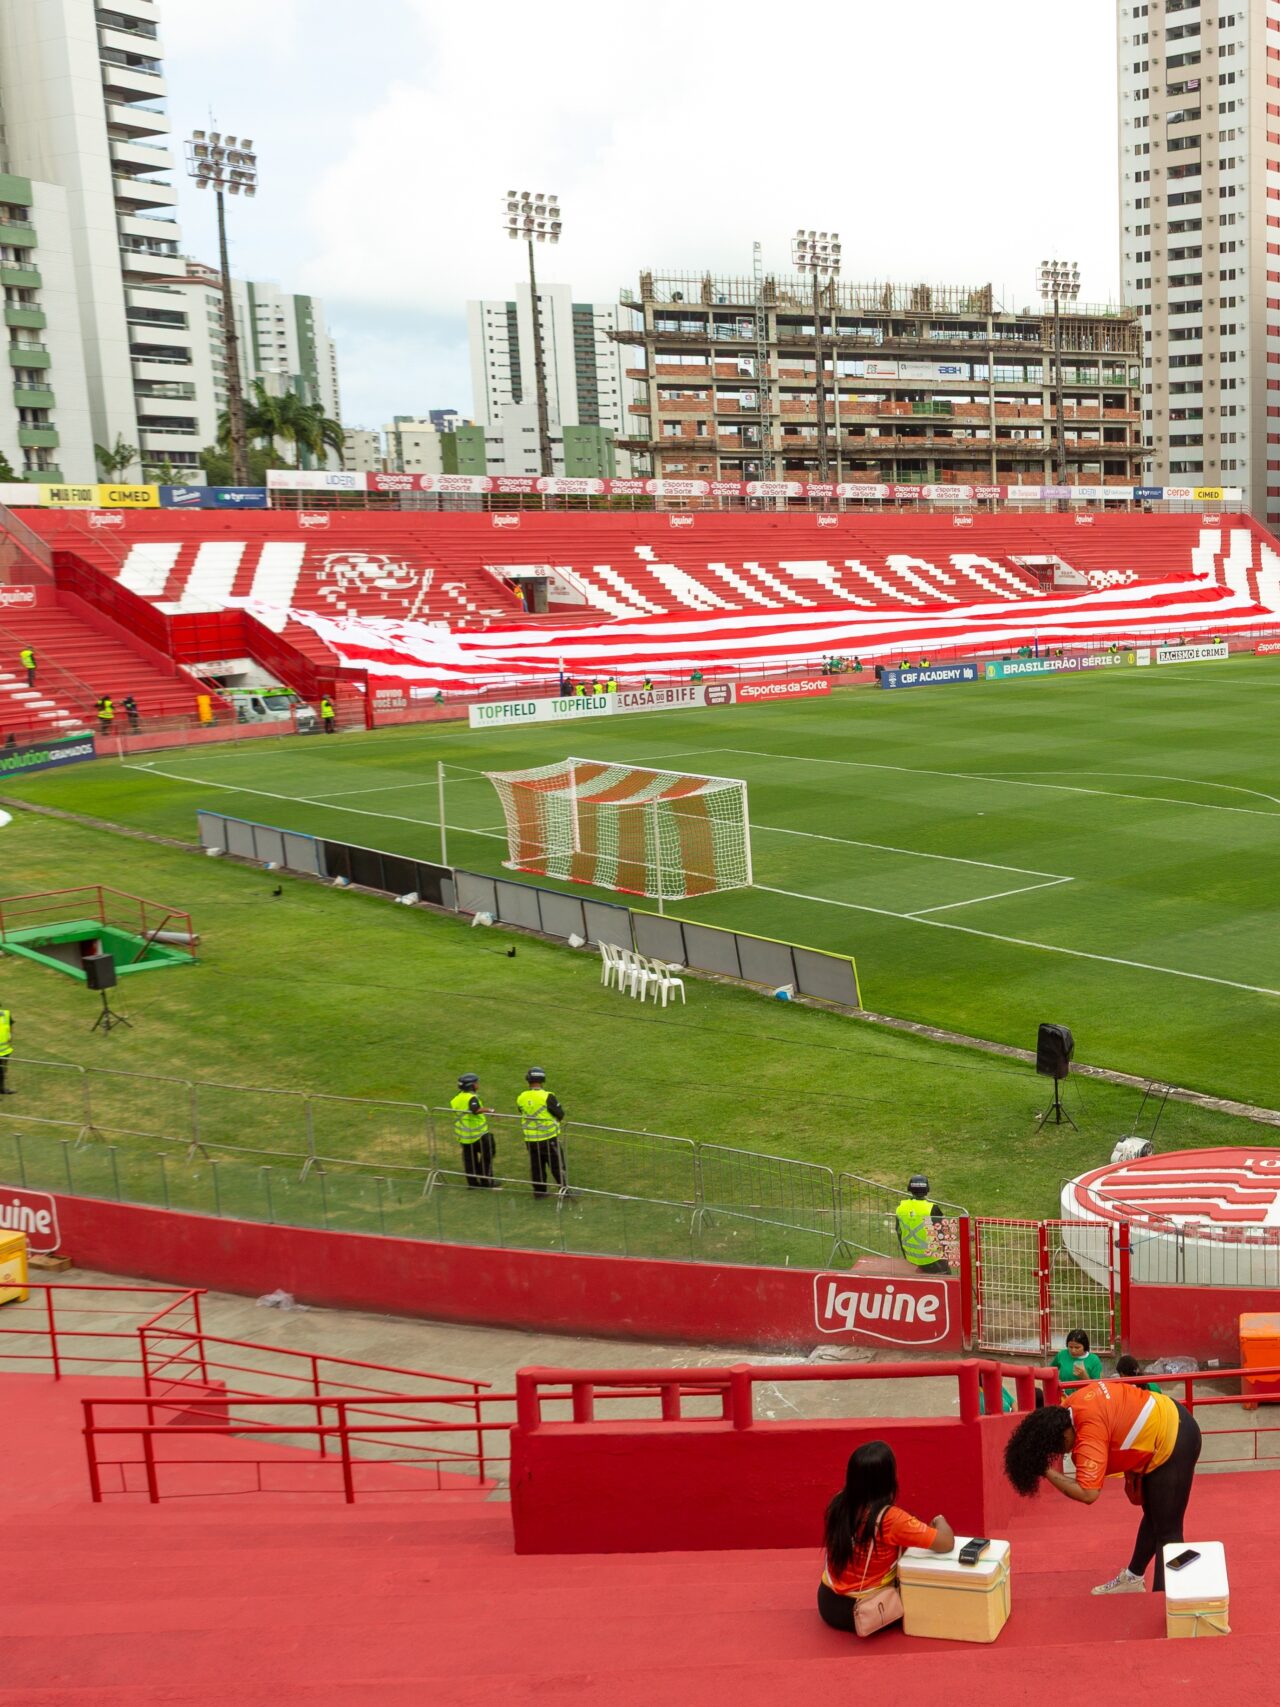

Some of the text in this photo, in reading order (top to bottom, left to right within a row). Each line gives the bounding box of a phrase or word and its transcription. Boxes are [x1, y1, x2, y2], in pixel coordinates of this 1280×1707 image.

[109, 490, 150, 502] CIMED
[1167, 488, 1190, 497] cerpe
[1198, 490, 1220, 498] CIMED
[493, 515, 519, 527] Iquine
[671, 515, 693, 526] Iquine
[818, 516, 837, 526] Iquine
[954, 516, 972, 526] Iquine
[1076, 515, 1093, 524] Iquine
[1202, 516, 1219, 524] Iquine
[0, 589, 34, 605] quine
[1160, 650, 1194, 661] RACISMO
[1196, 649, 1200, 658] É
[1202, 648, 1226, 658] CRIME!
[1003, 655, 1120, 674] BRASILEIRÃO SÉRIE C
[901, 670, 960, 683] CBF ACADEMY
[624, 692, 654, 706] CASA
[666, 688, 695, 702] BIFE
[552, 696, 606, 712] TOPFIELD
[477, 702, 536, 719] TOPFIELD
[0, 744, 93, 771] volution GRAMADOS
[824, 1282, 940, 1329] Iquine
